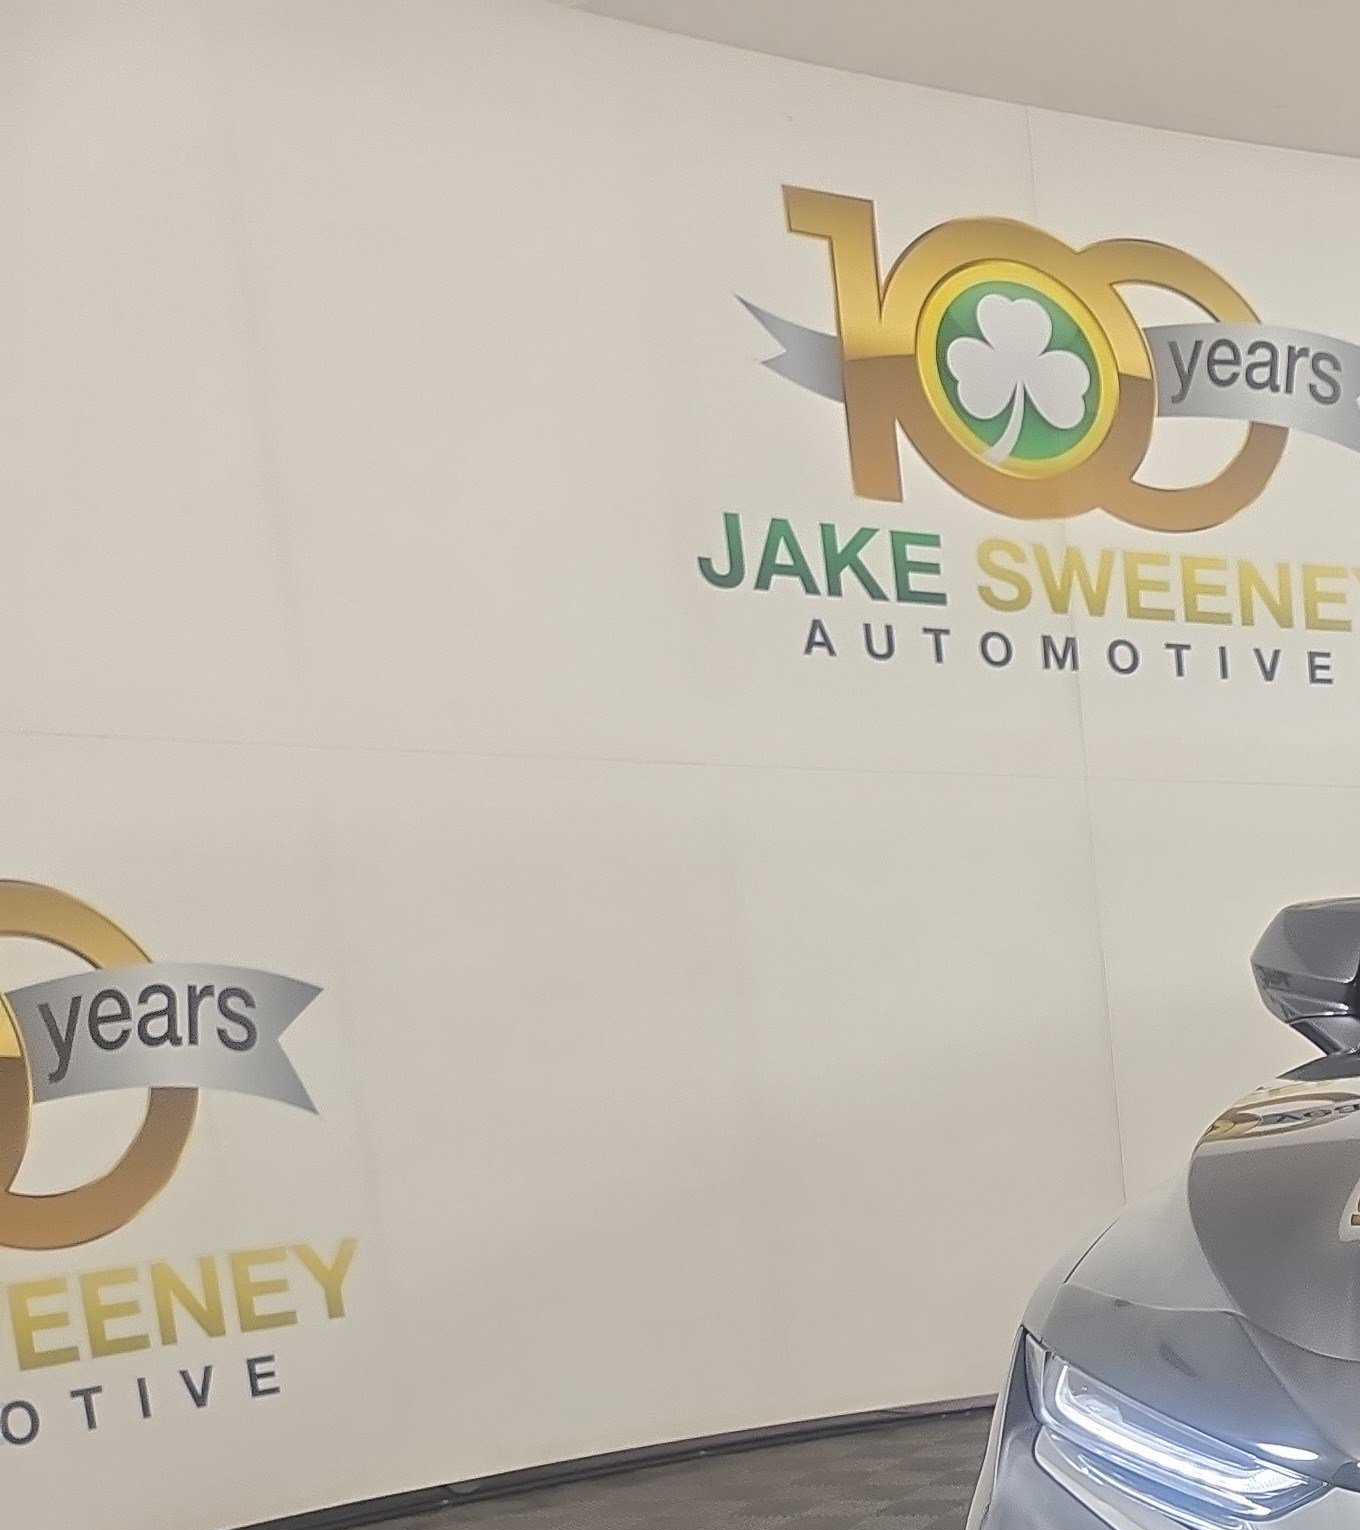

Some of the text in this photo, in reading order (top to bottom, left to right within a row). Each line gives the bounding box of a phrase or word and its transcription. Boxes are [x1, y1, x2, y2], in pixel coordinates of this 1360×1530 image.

[782, 184, 1343, 533] 100 years
[698, 512, 948, 606] JAKE
[803, 618, 1334, 685] AUTOMOTIVE
[37, 982, 259, 1084] years
